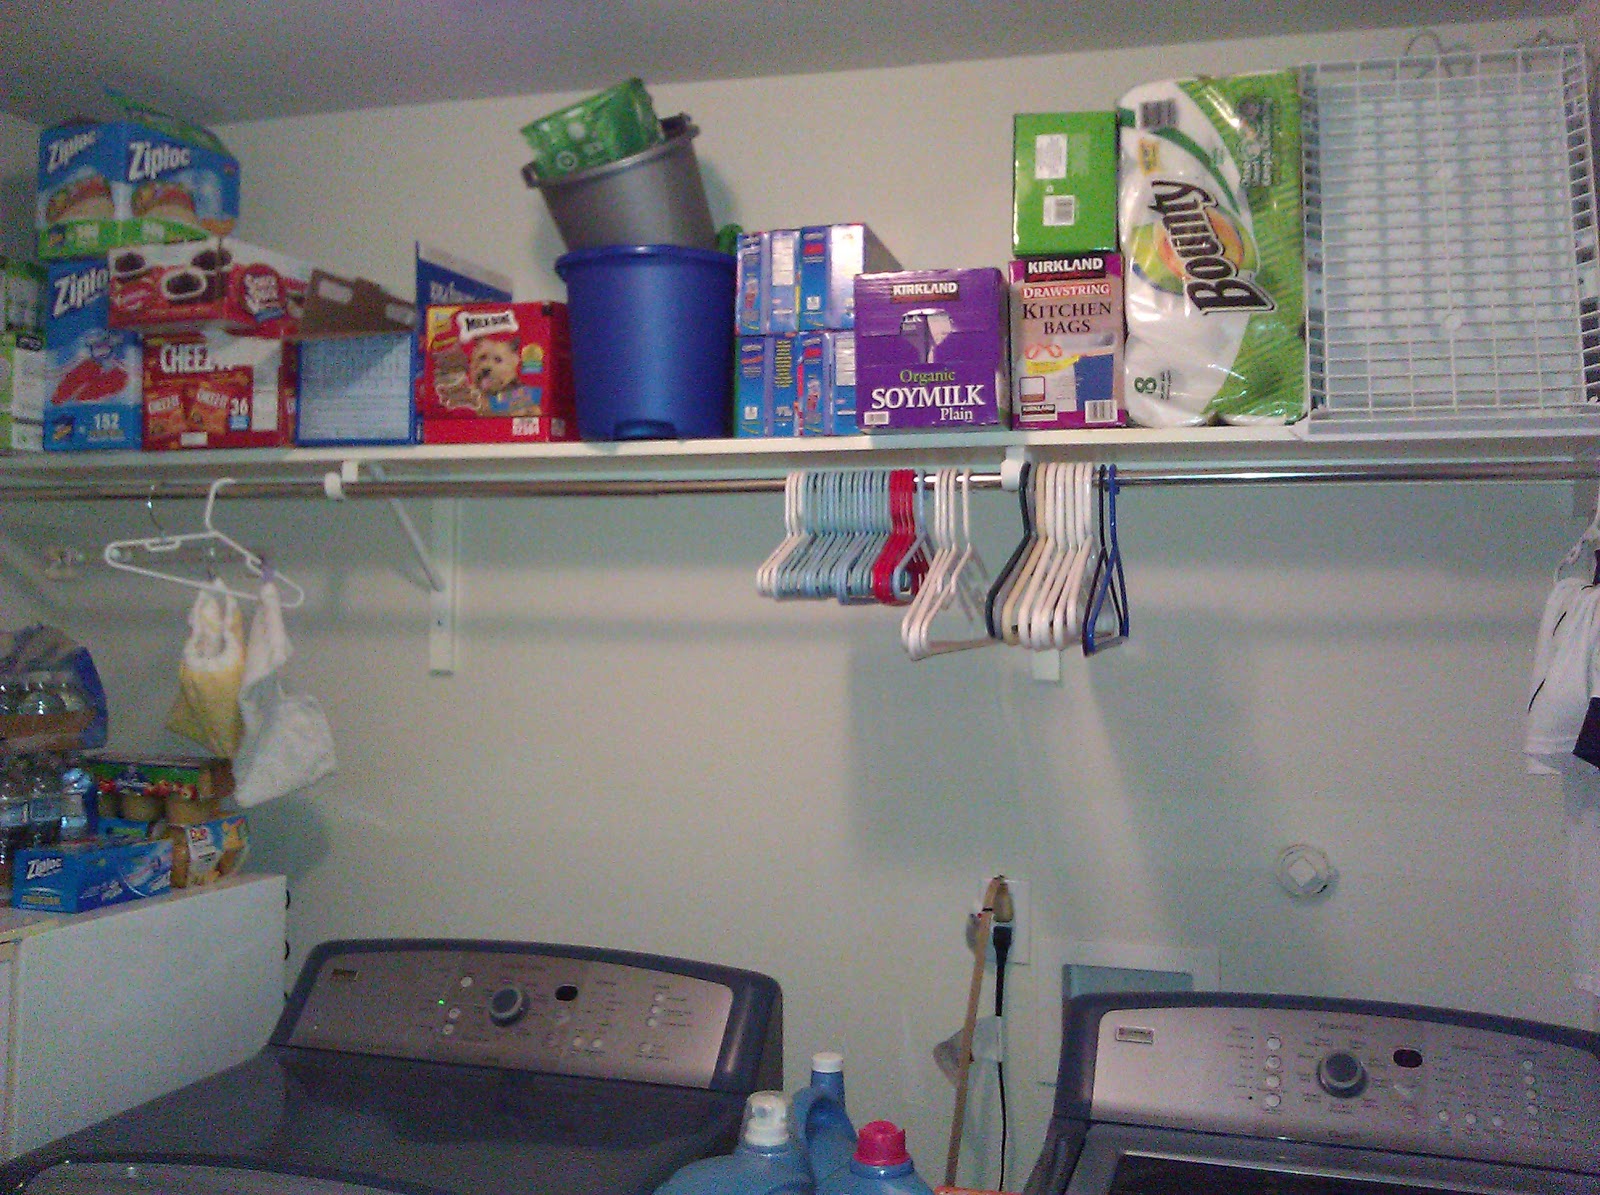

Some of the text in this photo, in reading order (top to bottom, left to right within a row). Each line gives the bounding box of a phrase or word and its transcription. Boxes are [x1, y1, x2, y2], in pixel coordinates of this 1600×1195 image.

[47, 131, 97, 173] Ziploc
[128, 141, 191, 182] Ziploc
[1148, 179, 1277, 317] Bounty
[1028, 258, 1104, 274] KIRKLAND
[53, 268, 110, 319] Ziplo
[892, 282, 959, 296] KIRKLAND
[1023, 284, 1110, 299] DRAWSTRING
[1023, 302, 1111, 319] KITCHEN
[1044, 319, 1091, 335] BAGS
[900, 367, 956, 386] Organic
[1134, 377, 1157, 394] 8
[871, 384, 987, 410] SOYMILK
[940, 408, 974, 422] Plain
[26, 856, 64, 880] Ziploc
